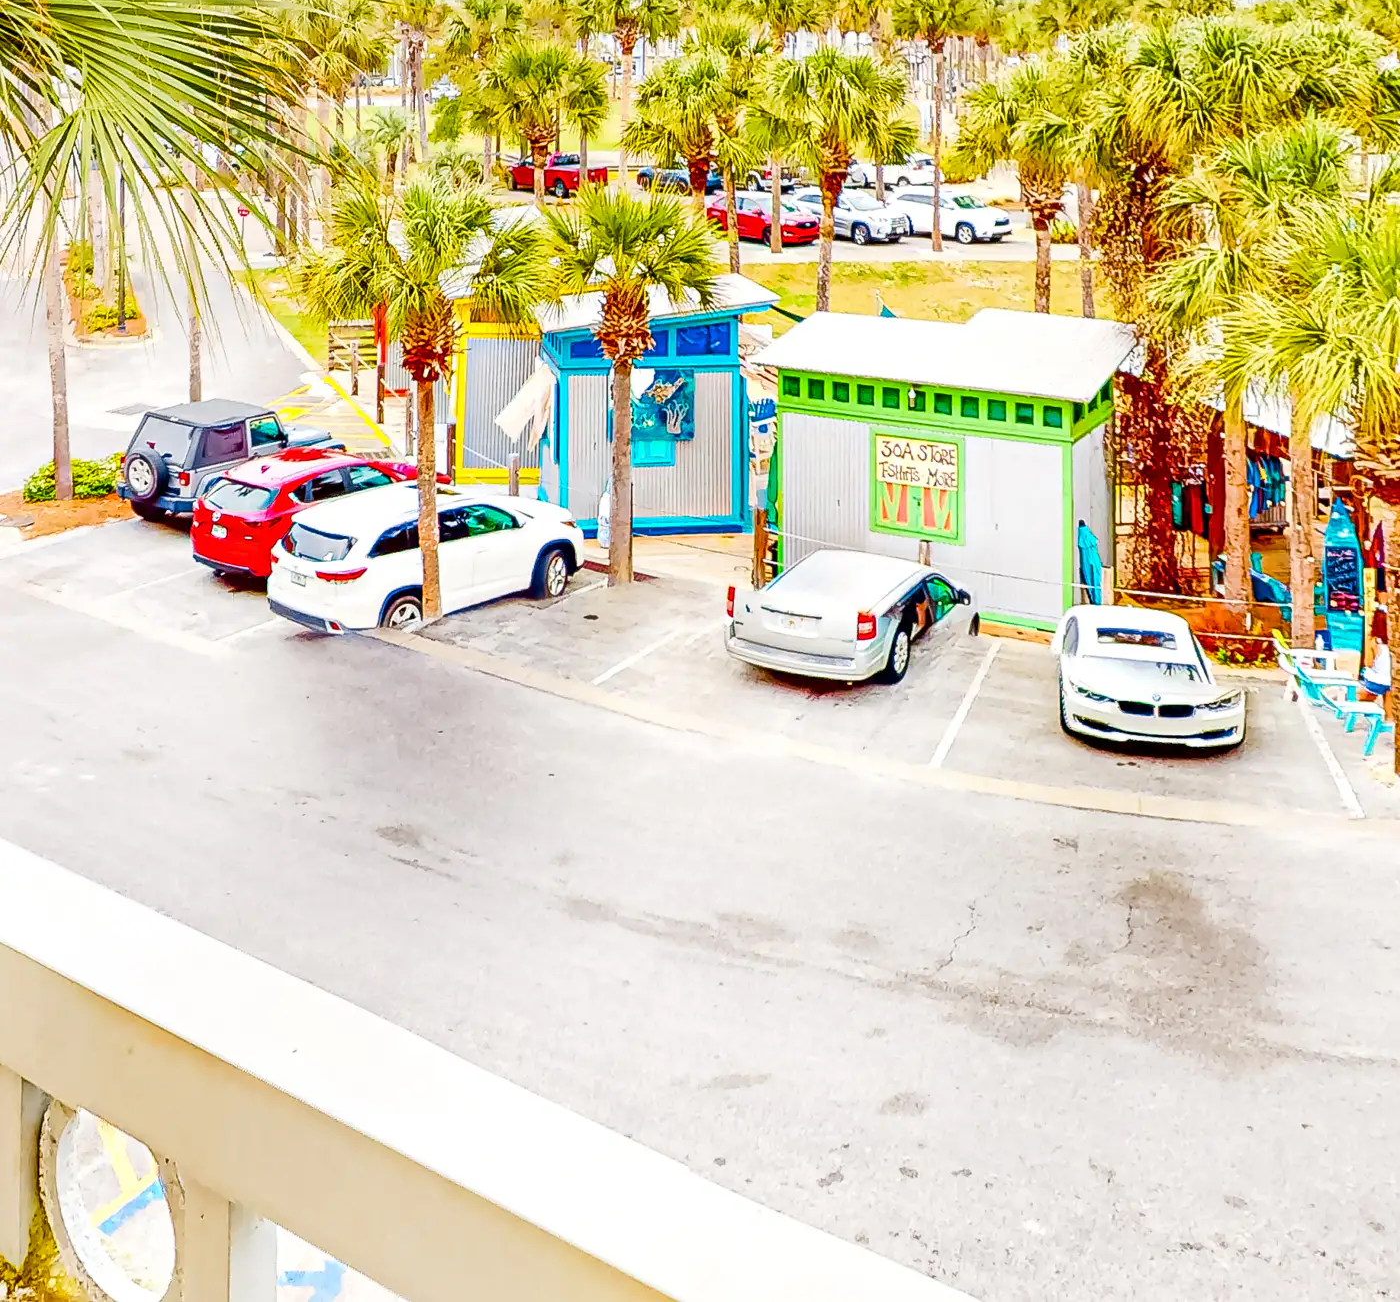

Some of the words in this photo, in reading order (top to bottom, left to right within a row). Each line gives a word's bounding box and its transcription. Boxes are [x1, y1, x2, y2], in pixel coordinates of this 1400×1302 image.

[881, 440, 914, 461] 30A
[917, 444, 955, 466] STORE
[926, 468, 957, 488] MORE
